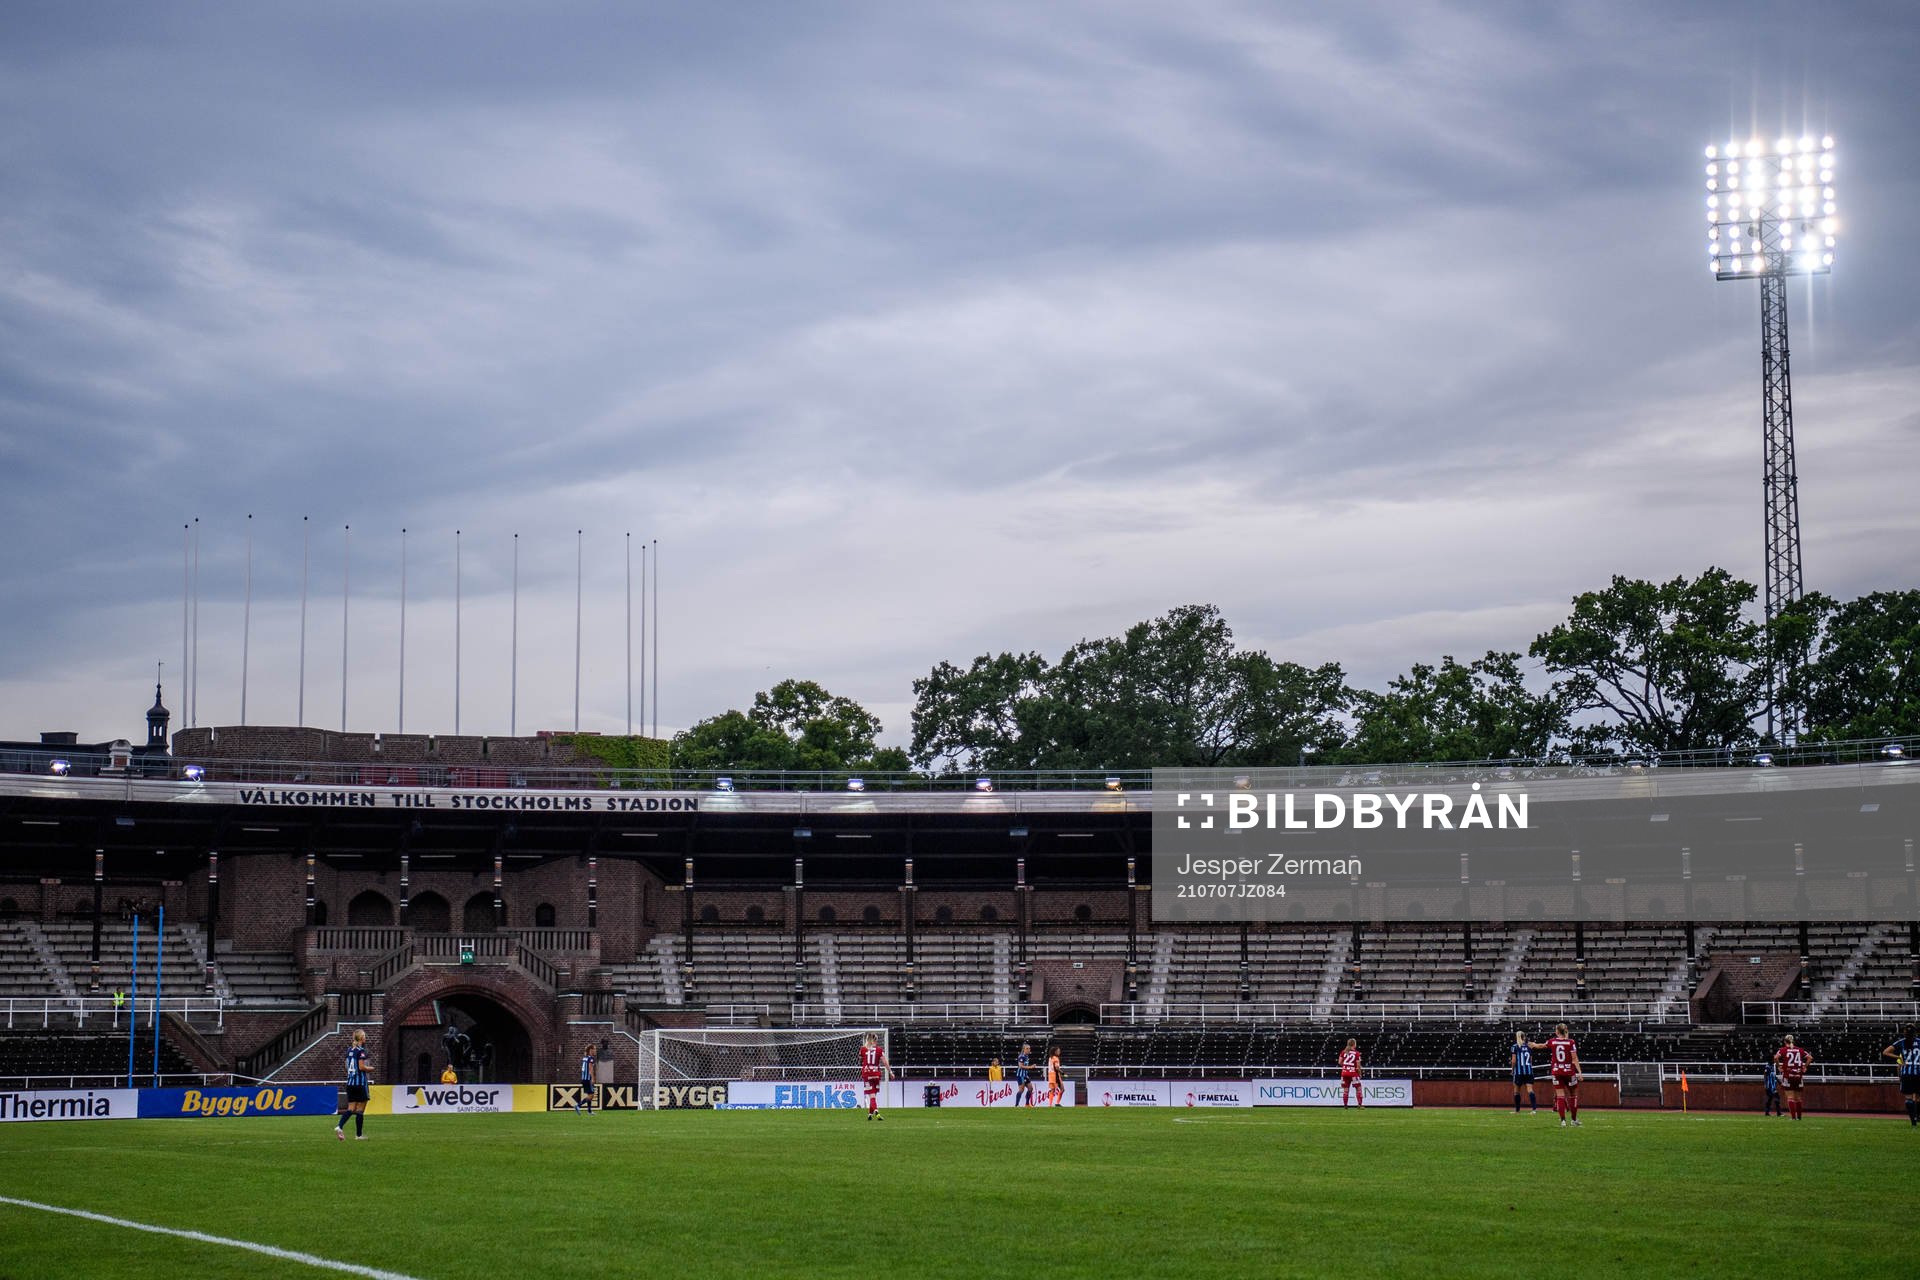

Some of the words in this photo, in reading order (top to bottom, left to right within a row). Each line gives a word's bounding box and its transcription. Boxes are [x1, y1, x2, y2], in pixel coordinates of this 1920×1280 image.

[239, 787, 376, 807] VÄLKOMMEN
[392, 793, 436, 808] TILL
[451, 795, 592, 811] STOCKHOLMS
[606, 797, 700, 812] STADION
[865, 1050, 876, 1065] 11
[1343, 1053, 1356, 1066] 22
[1520, 1051, 1531, 1066] 12
[1556, 1045, 1566, 1063] 6
[1786, 1052, 1802, 1067] 24
[0, 1092, 110, 1118] Thermia
[425, 1086, 500, 1106] weber
[606, 1086, 726, 1107] XL-BYGG
[775, 1085, 858, 1109] Flinks
